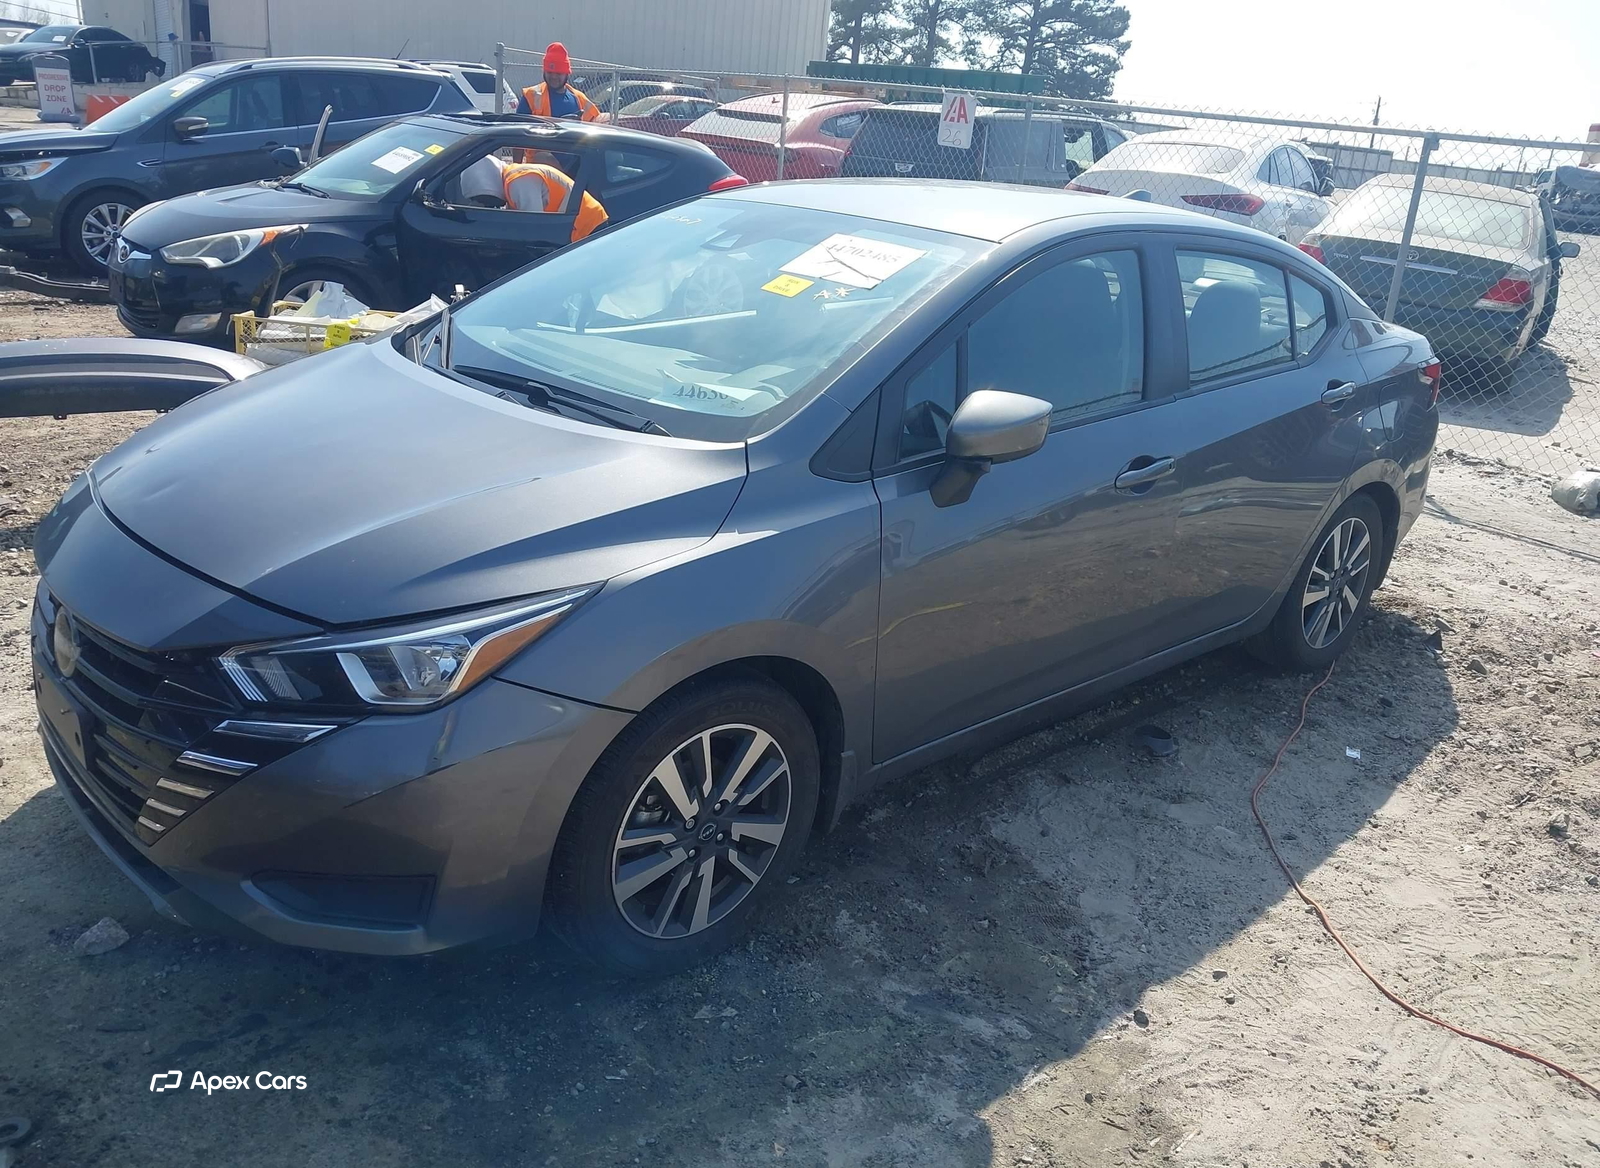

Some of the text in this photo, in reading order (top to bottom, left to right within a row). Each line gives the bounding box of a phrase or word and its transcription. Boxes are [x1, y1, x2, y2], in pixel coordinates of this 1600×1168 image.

[44, 84, 66, 92] DROP
[46, 94, 67, 102] ZONE
[942, 129, 961, 146] 26
